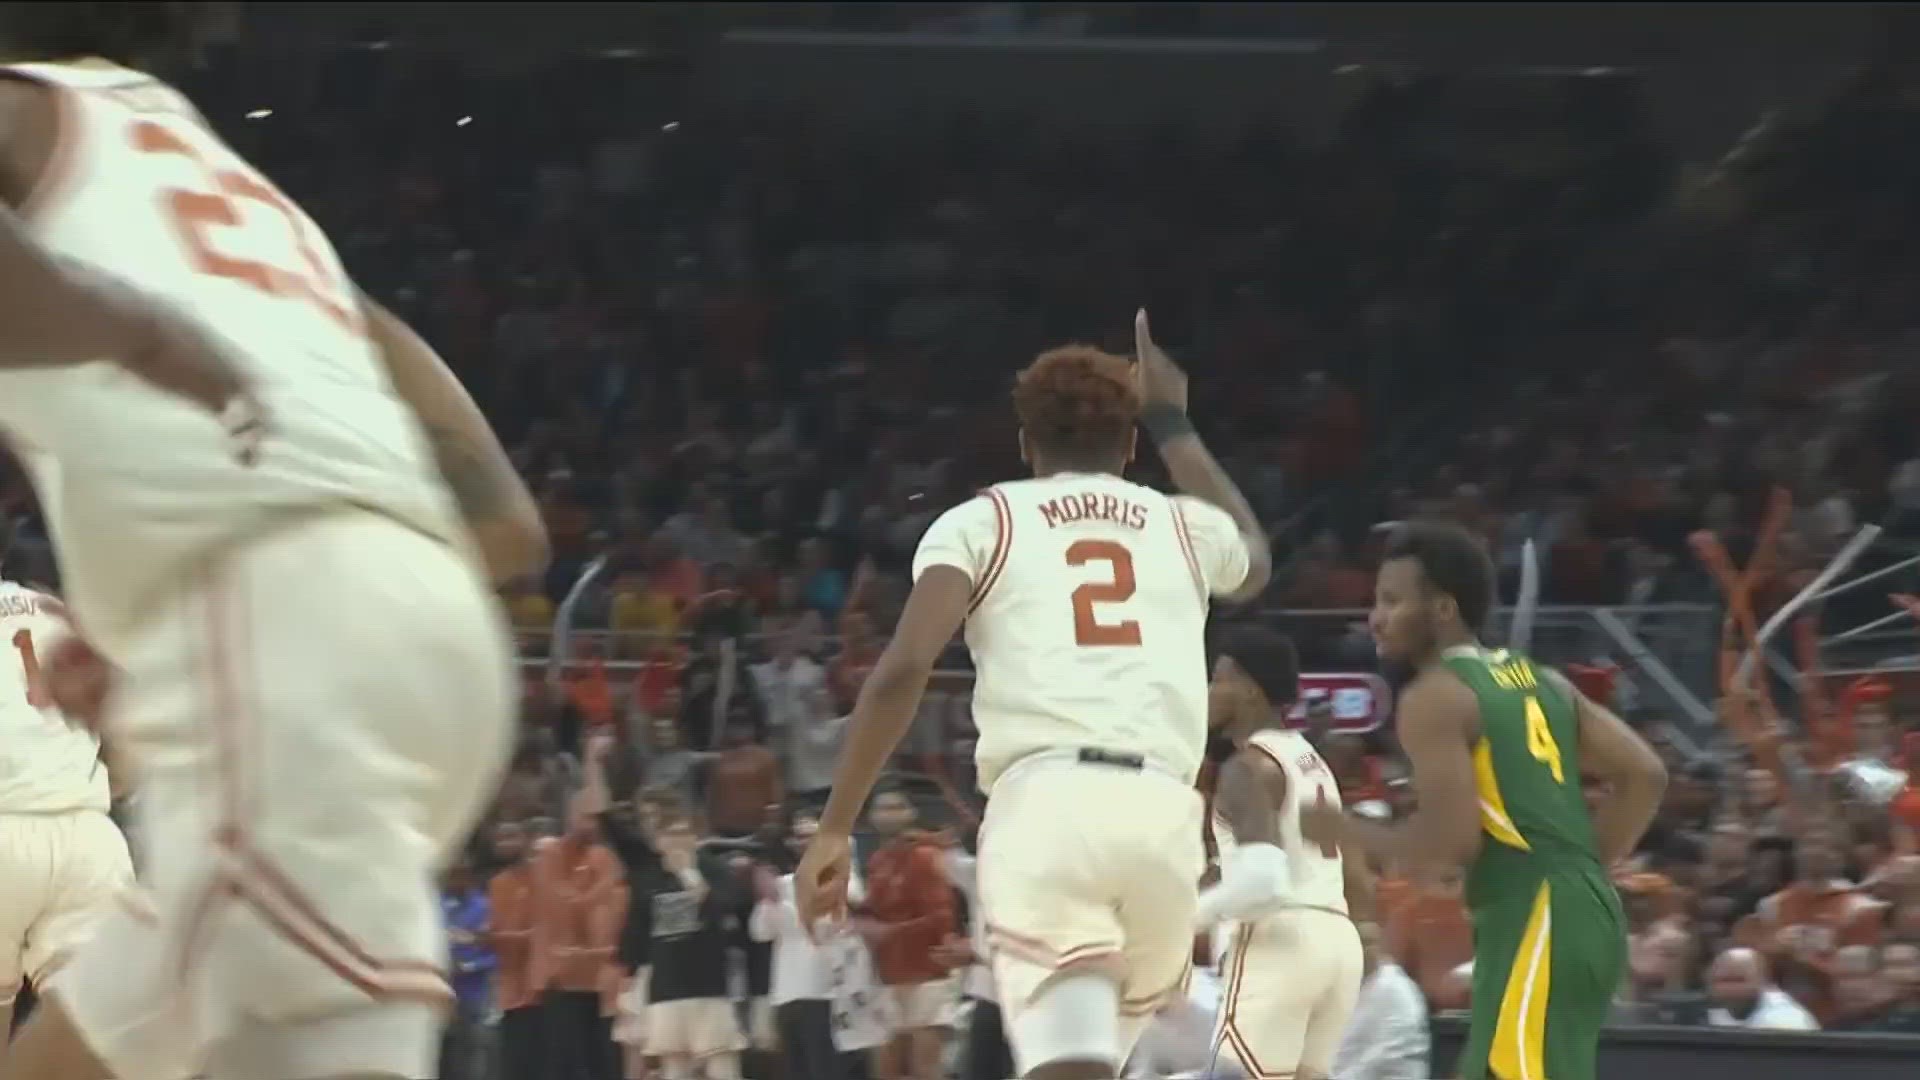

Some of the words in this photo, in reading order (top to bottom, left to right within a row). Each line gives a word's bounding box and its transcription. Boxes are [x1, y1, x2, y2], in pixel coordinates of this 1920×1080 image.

[1038, 491, 1148, 530] MORRIS
[1065, 538, 1142, 647] 2
[1524, 696, 1565, 785] 4
